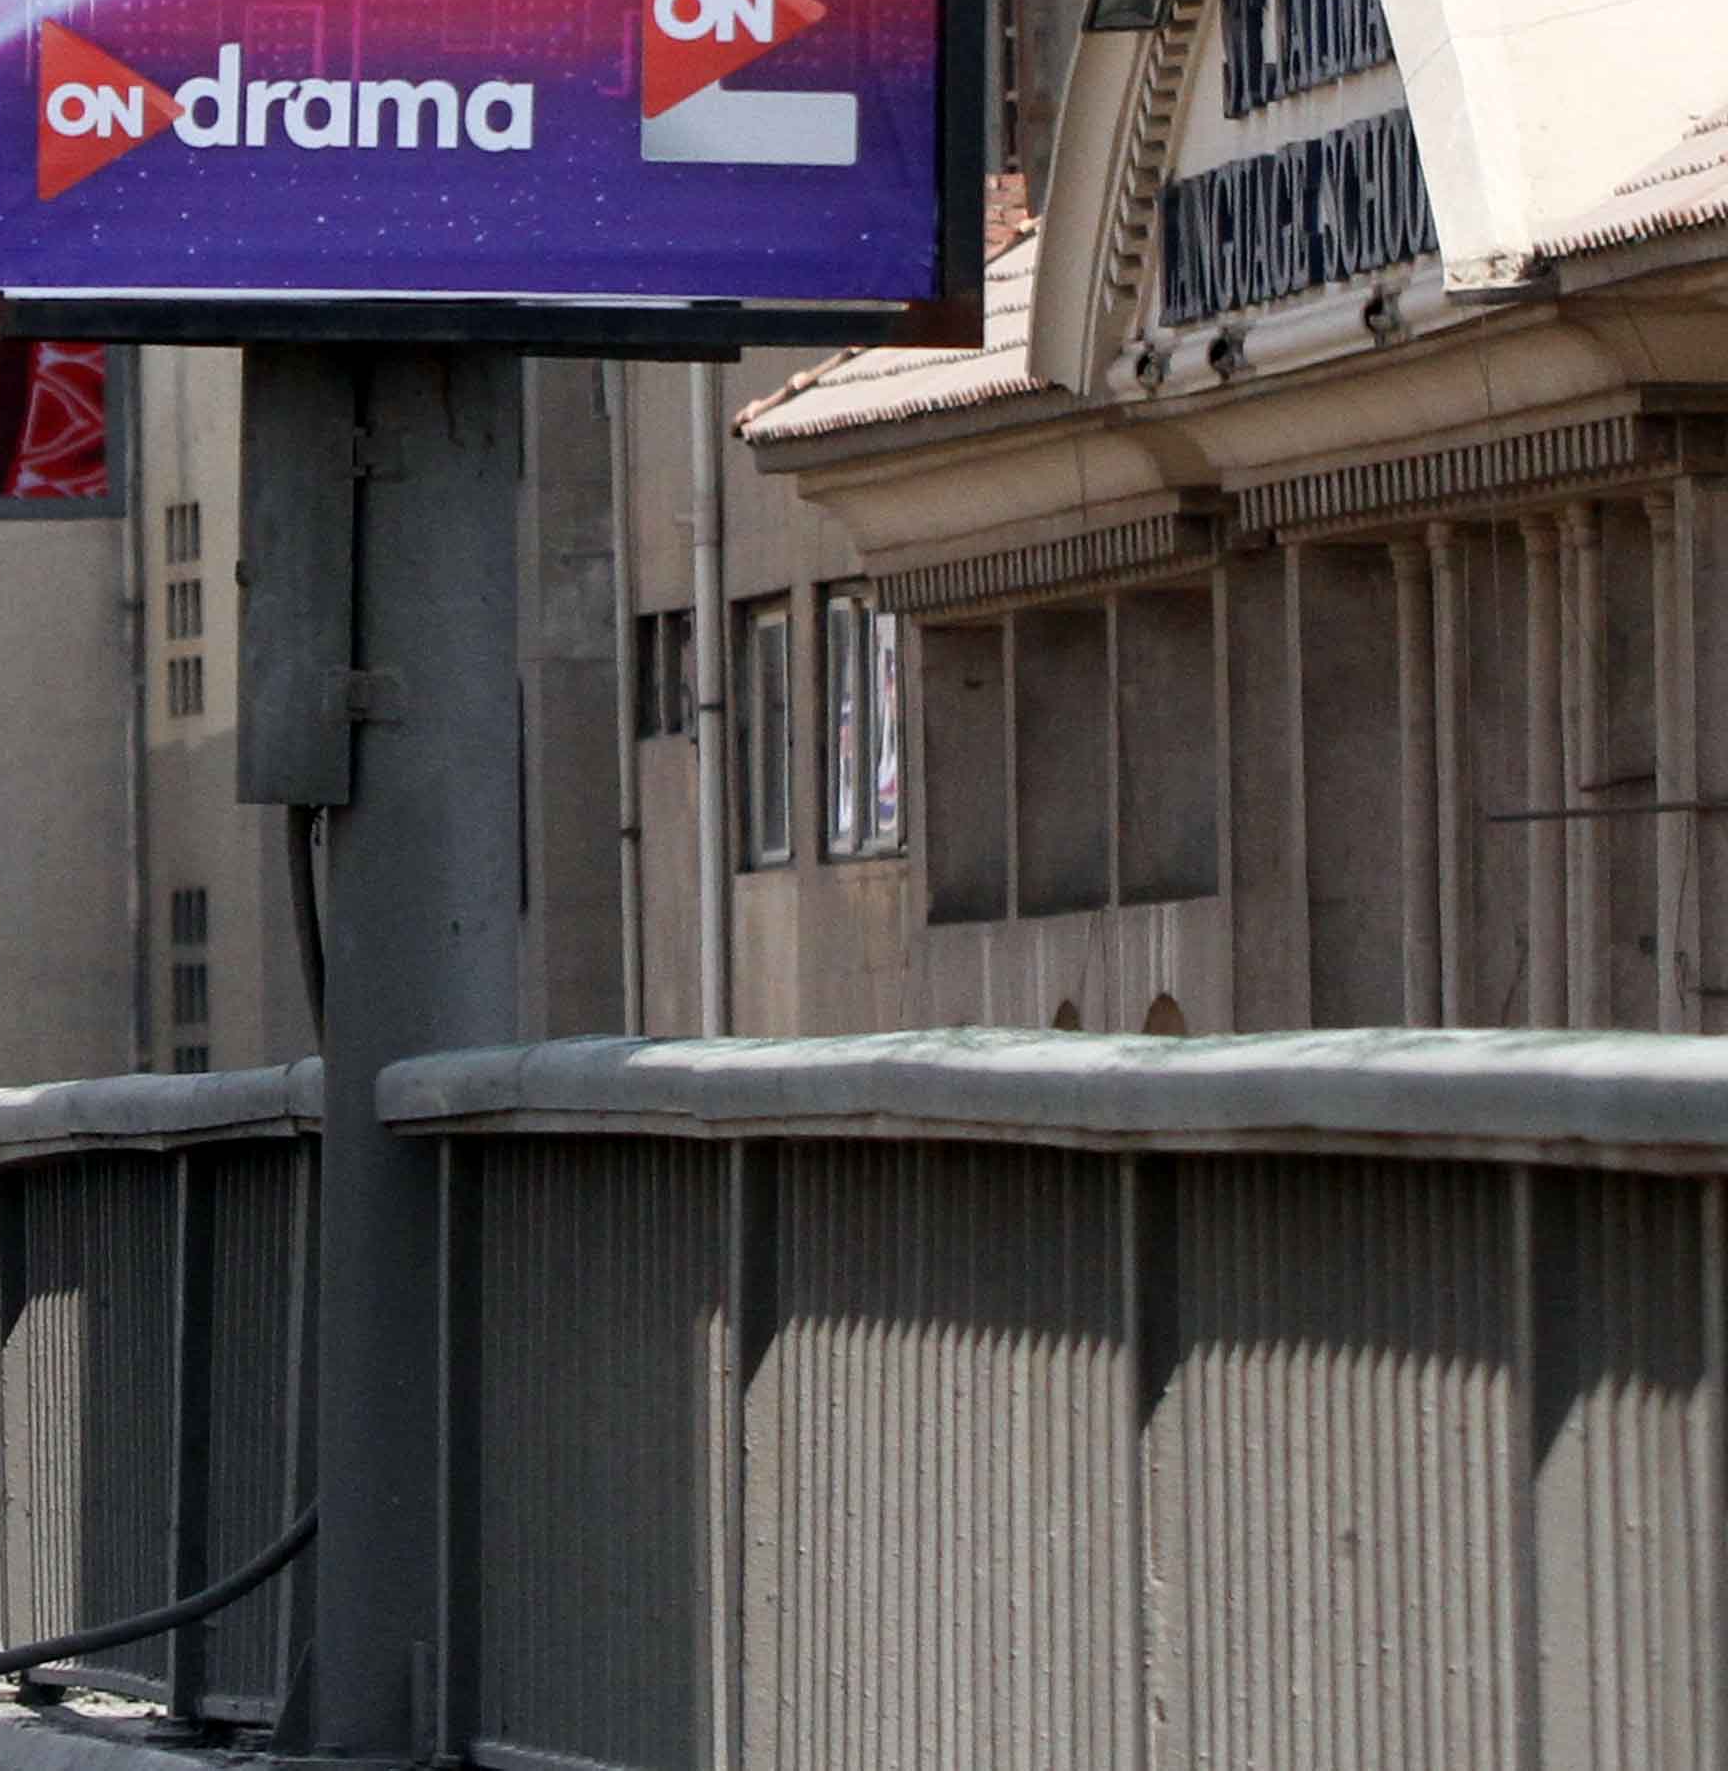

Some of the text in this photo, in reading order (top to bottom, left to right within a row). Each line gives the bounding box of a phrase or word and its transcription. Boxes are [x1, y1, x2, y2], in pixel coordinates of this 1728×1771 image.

[46, 42, 535, 151] ON drama
[1158, 138, 1324, 328] LANGUAGE
